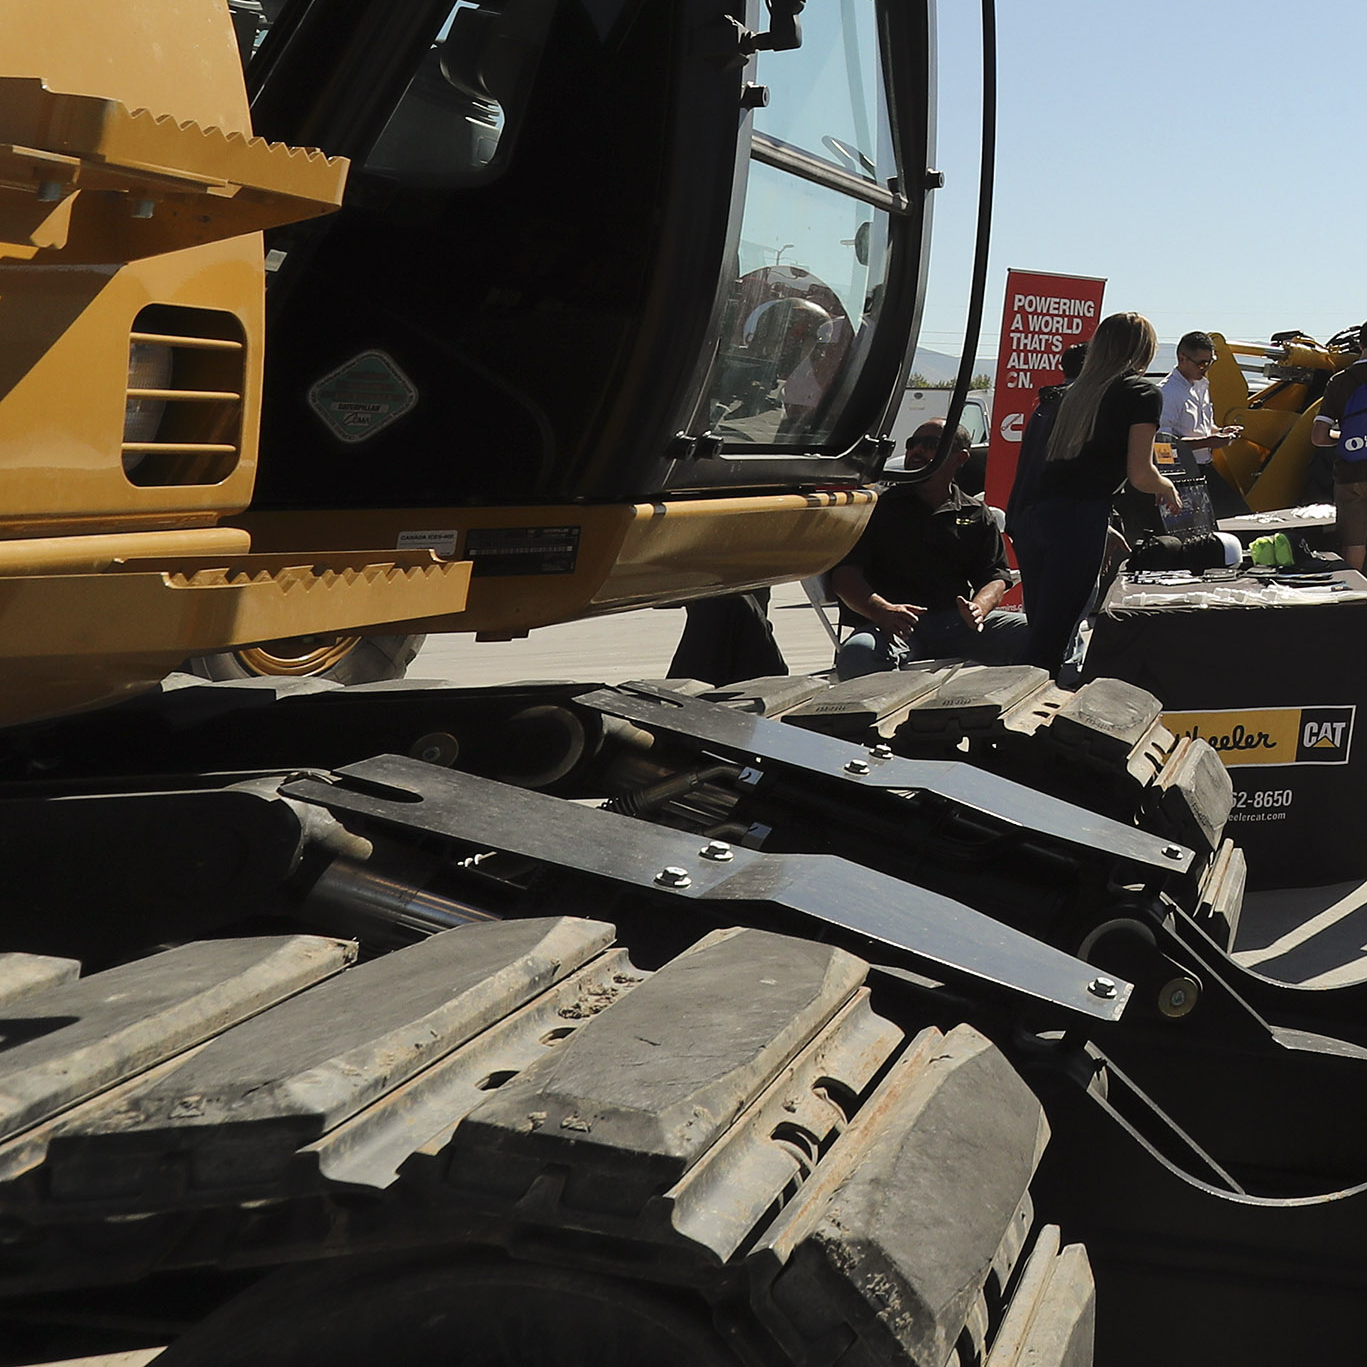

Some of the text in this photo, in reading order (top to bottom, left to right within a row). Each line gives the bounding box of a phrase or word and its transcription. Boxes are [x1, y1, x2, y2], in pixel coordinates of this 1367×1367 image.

[1012, 294, 1095, 318] POWERING
[1010, 313, 1083, 334] A WORLD
[1009, 332, 1063, 352] THAT'S
[1303, 721, 1347, 748] CAT
